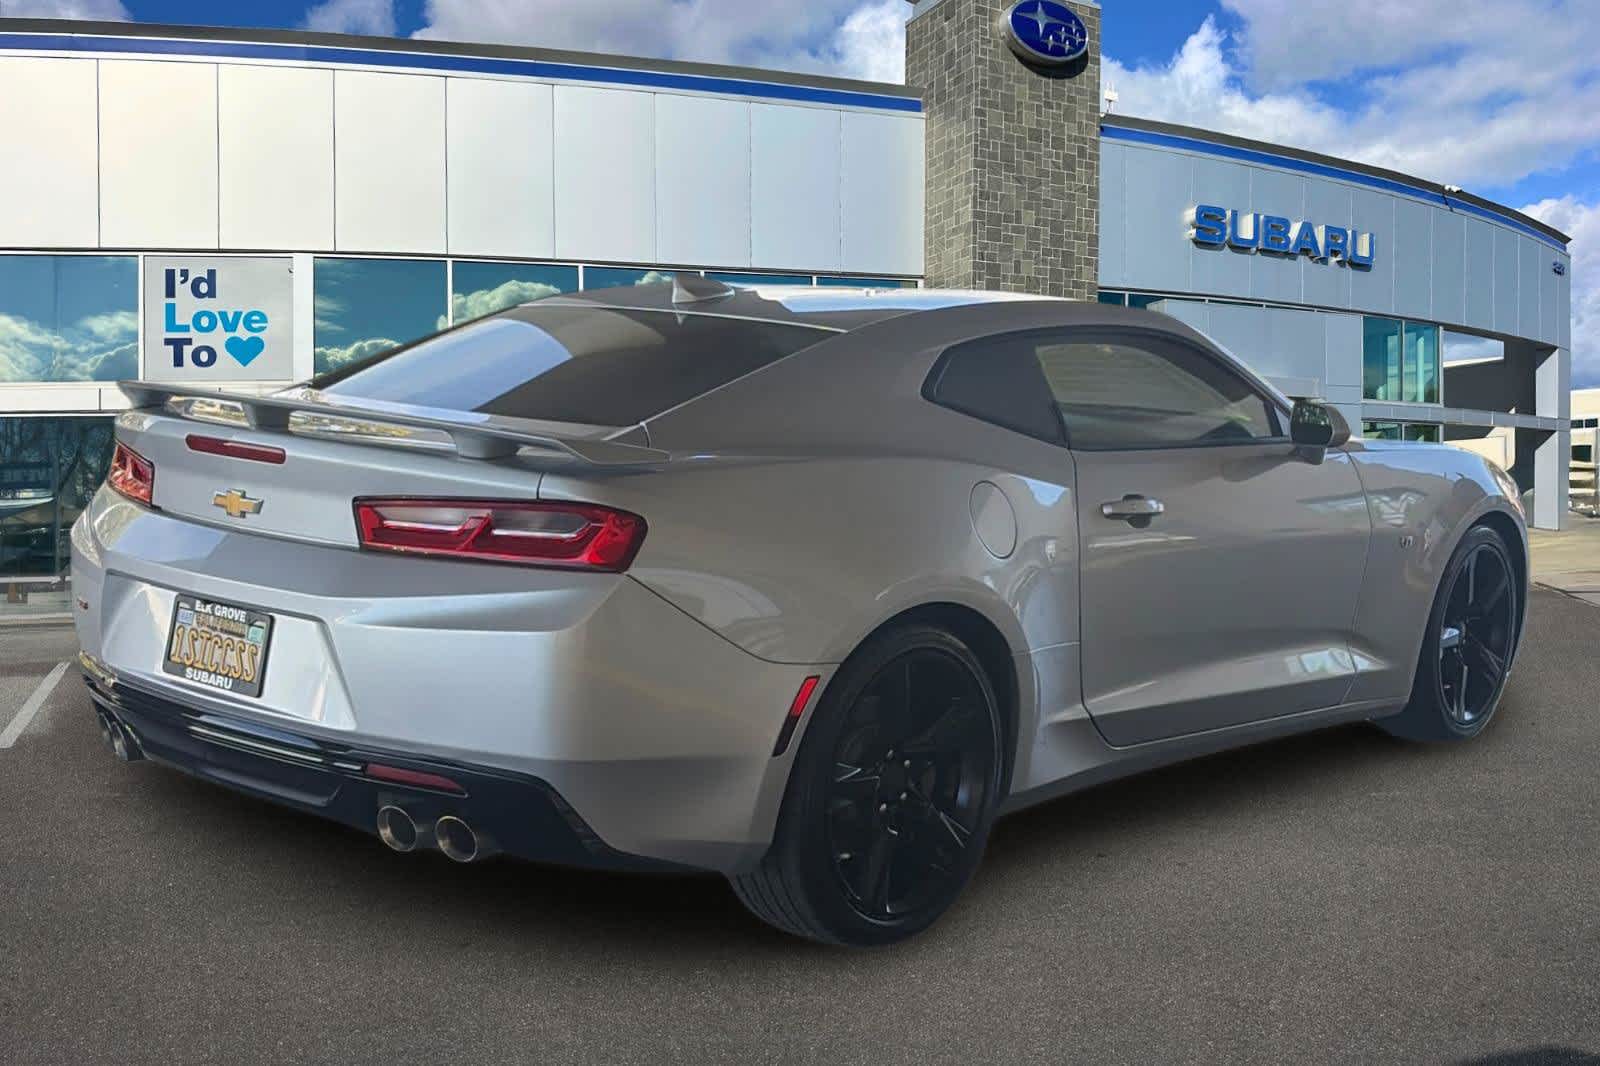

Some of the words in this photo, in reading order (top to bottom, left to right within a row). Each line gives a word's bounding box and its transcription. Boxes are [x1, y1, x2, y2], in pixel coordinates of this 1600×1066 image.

[1194, 205, 1376, 266] SUBARU
[165, 268, 217, 299] I'd
[165, 302, 268, 333] Love
[164, 337, 217, 368] To
[195, 600, 213, 614] ELK
[214, 604, 247, 622] GROVE
[186, 667, 233, 690] SUBARU
